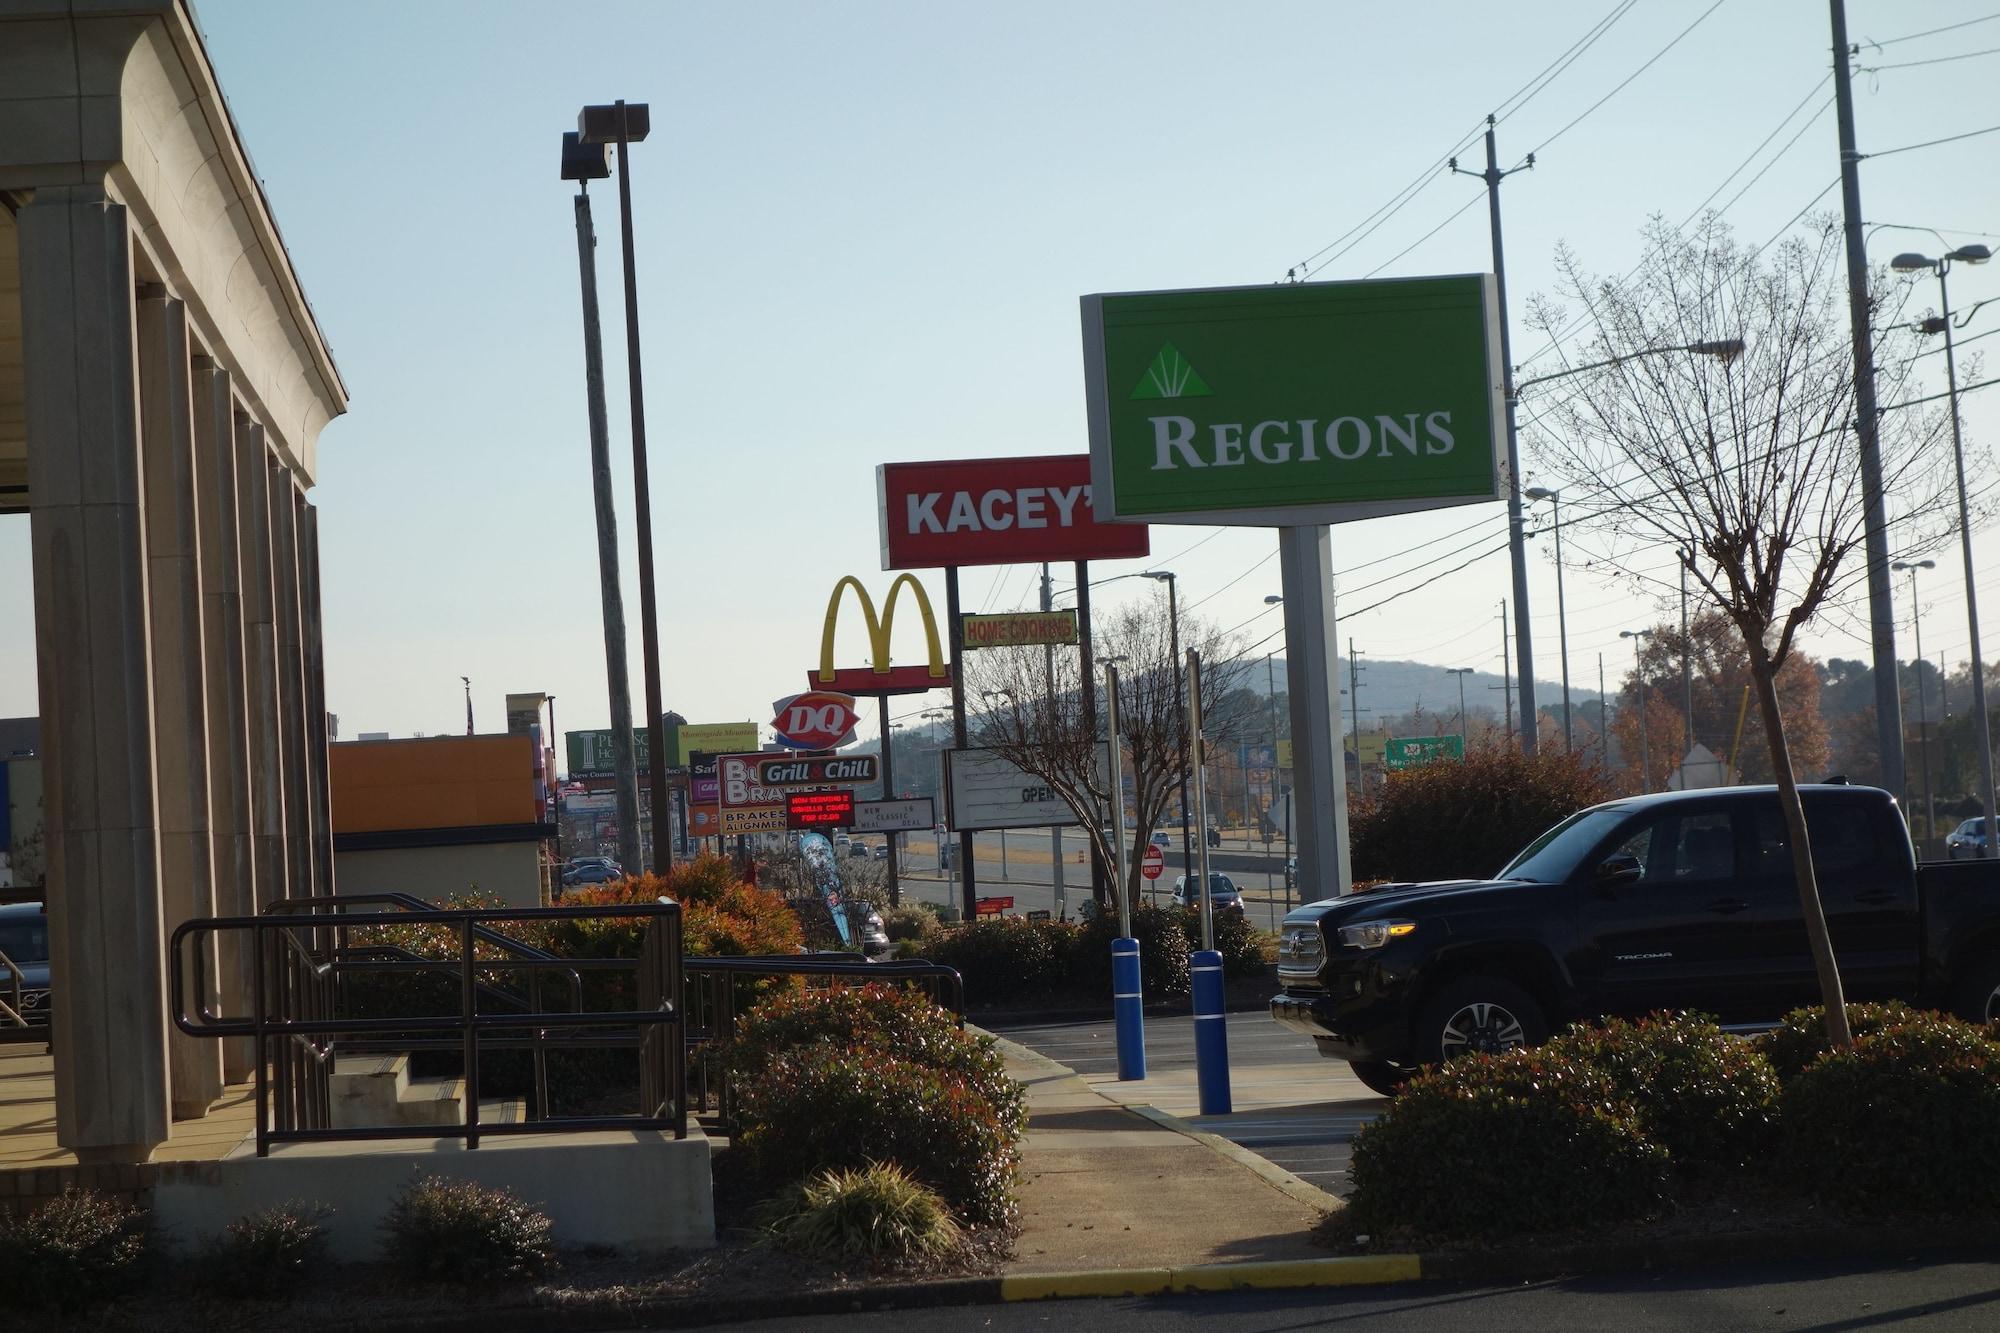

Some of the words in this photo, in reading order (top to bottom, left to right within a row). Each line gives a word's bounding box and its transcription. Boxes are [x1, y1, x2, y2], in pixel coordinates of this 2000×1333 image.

[1147, 410, 1455, 470] REGIONS
[906, 485, 1093, 535] KACEY'
[967, 620, 1007, 641] HOME
[786, 703, 845, 736] DQ
[767, 763, 809, 782] Grill
[825, 760, 870, 779] Chill
[725, 811, 786, 822] BRAKES
[864, 807, 881, 815] NEW
[876, 813, 909, 821] CLASSIC
[1615, 951, 1673, 961] TACOMA
